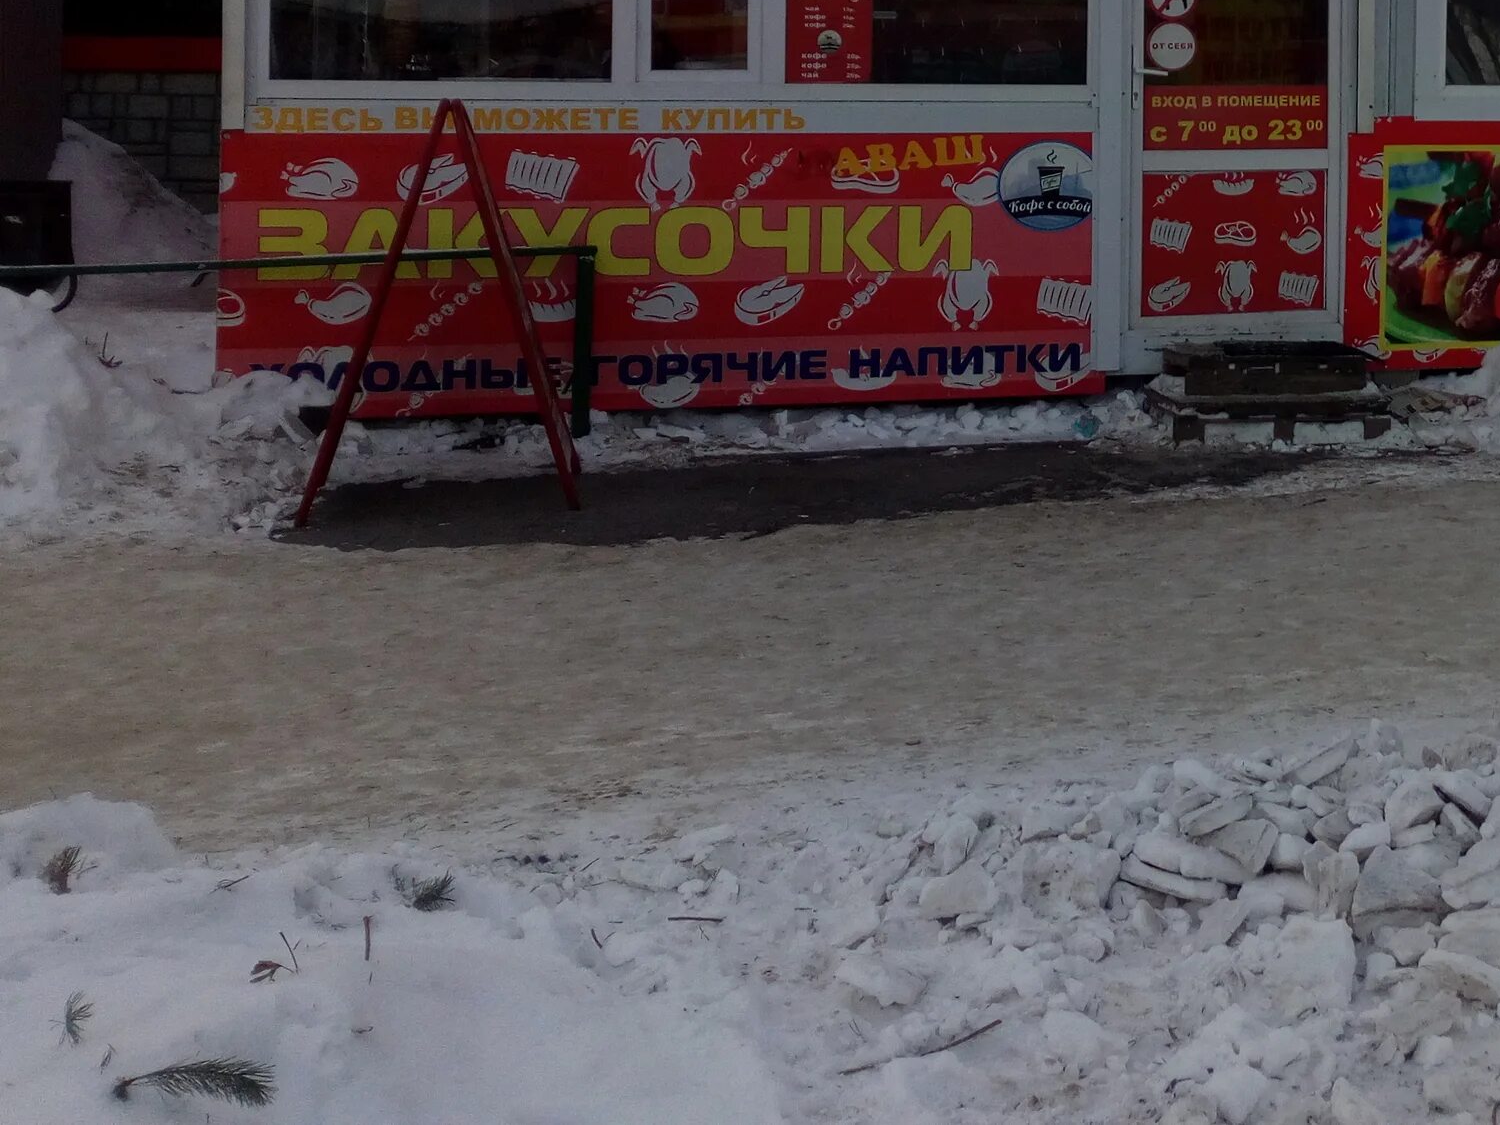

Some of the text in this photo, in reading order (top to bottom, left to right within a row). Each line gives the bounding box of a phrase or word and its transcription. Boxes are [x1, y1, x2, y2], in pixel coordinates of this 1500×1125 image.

[1152, 42, 1193, 50] ОТ СЕБЯ
[1151, 95, 1320, 109] ВХОД В ПОМЕЩЕНИЕ
[252, 106, 384, 134] ЗДЕСЬ
[472, 107, 640, 132] МОЖЕТЕ
[660, 107, 806, 132] КУПИТЬ
[1222, 125, 1258, 145] до
[1008, 198, 1091, 213] Кофе с собой
[257, 205, 973, 282] ЗАКУСОЧКИ
[849, 342, 1081, 378] НАПИТКИ
